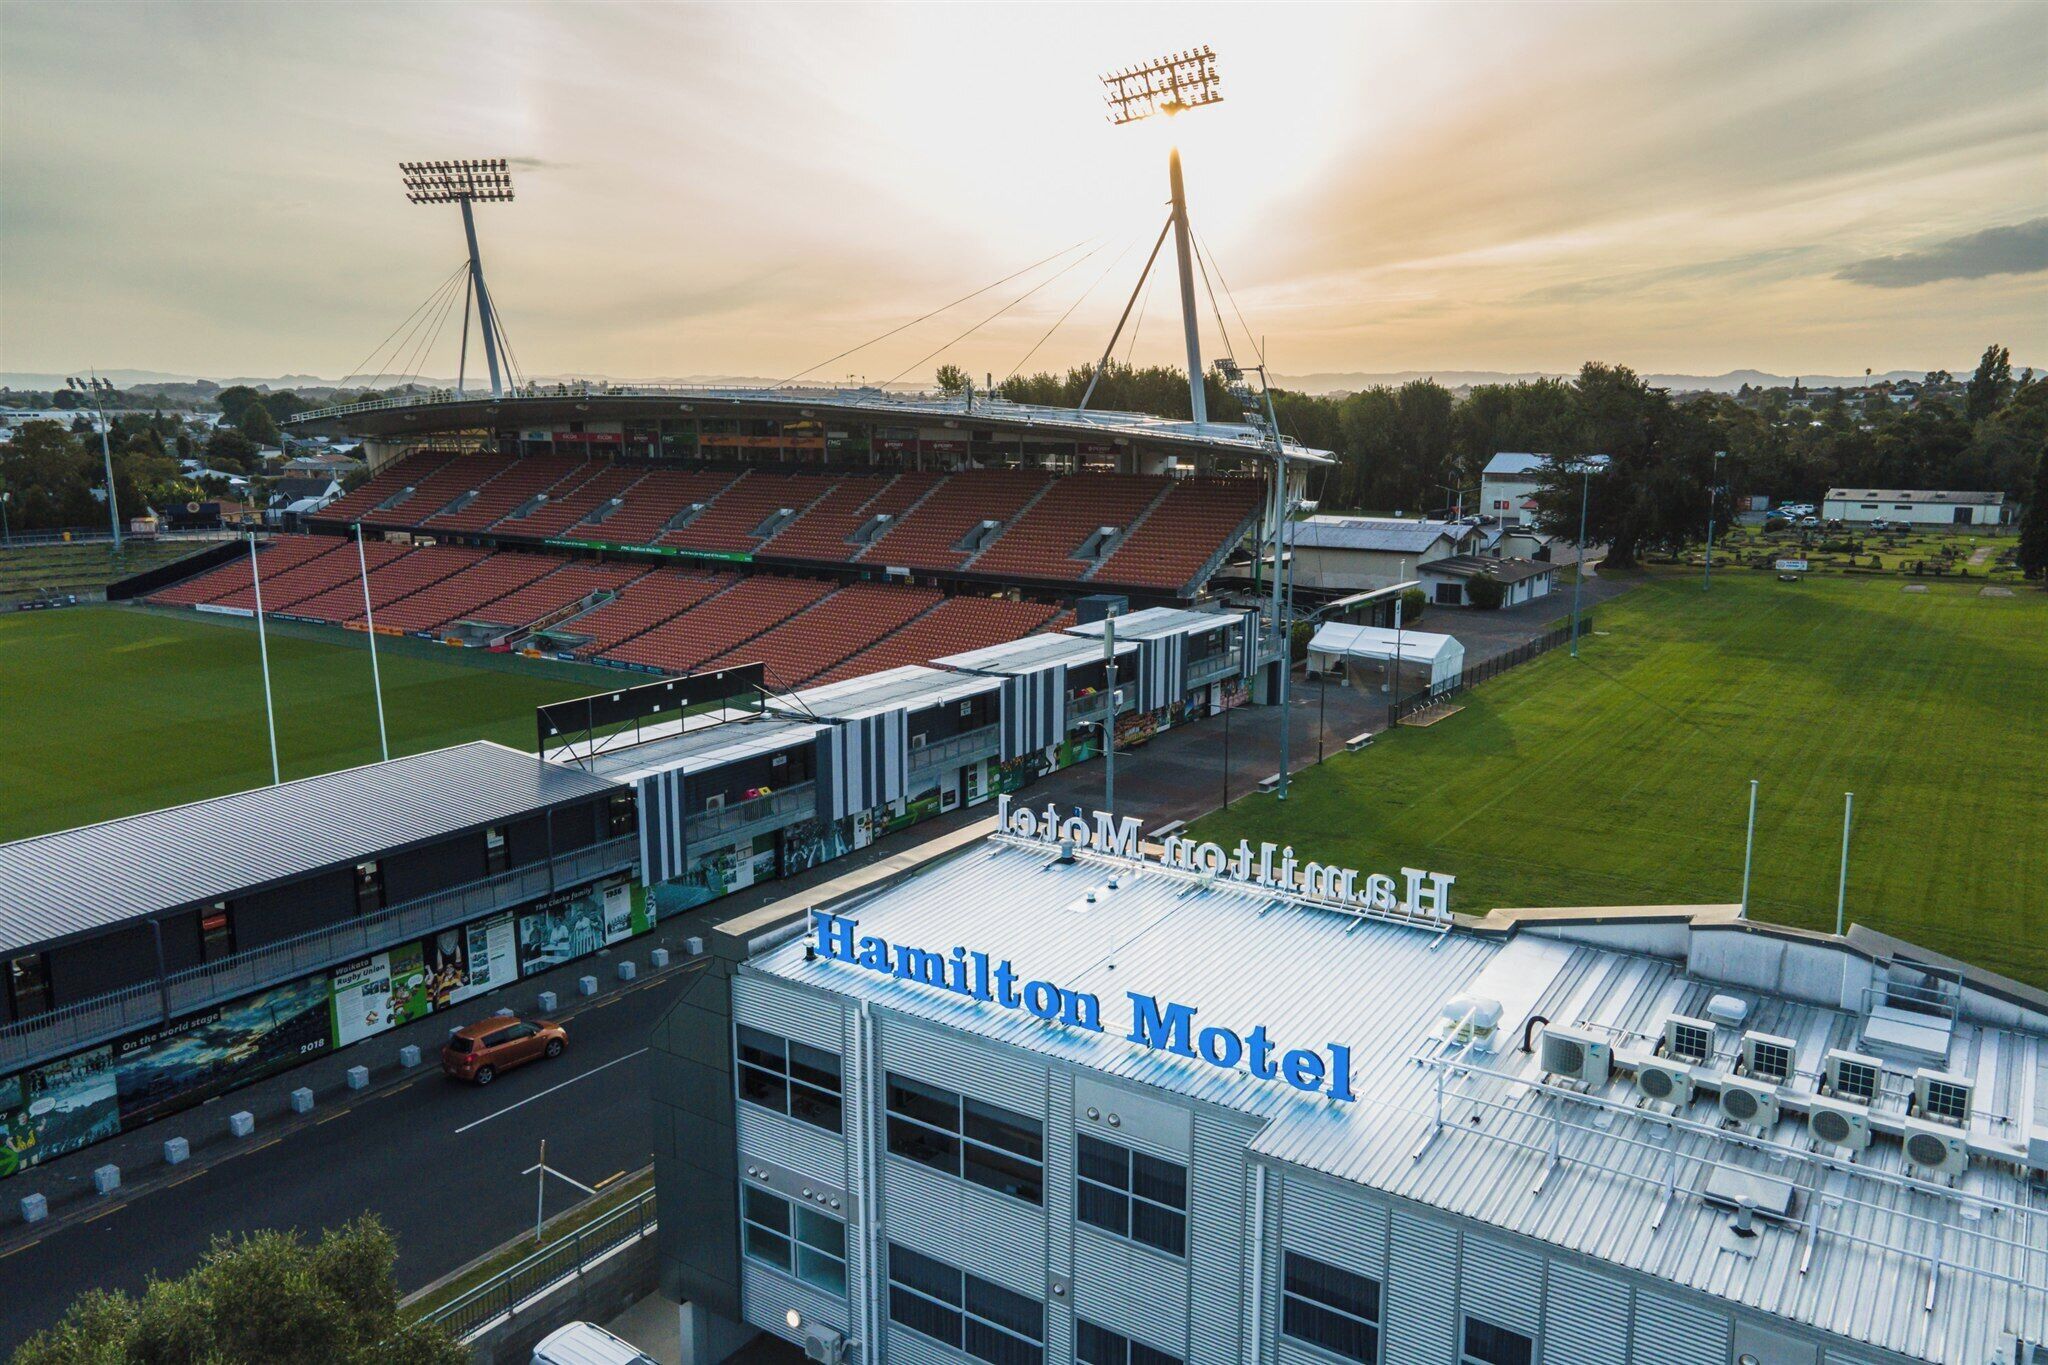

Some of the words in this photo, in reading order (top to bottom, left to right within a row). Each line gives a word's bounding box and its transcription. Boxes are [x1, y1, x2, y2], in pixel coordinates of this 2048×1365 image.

[335, 959, 369, 976] Waikato
[337, 971, 362, 985] Rugby
[363, 964, 385, 976] Union
[811, 908, 1104, 1032] Hamilton
[1126, 991, 1357, 1102] Motel
[122, 1041, 137, 1051] On
[139, 1033, 157, 1045] the
[159, 1021, 189, 1038] world
[191, 1012, 219, 1028] stage
[300, 1038, 325, 1054] 2018
